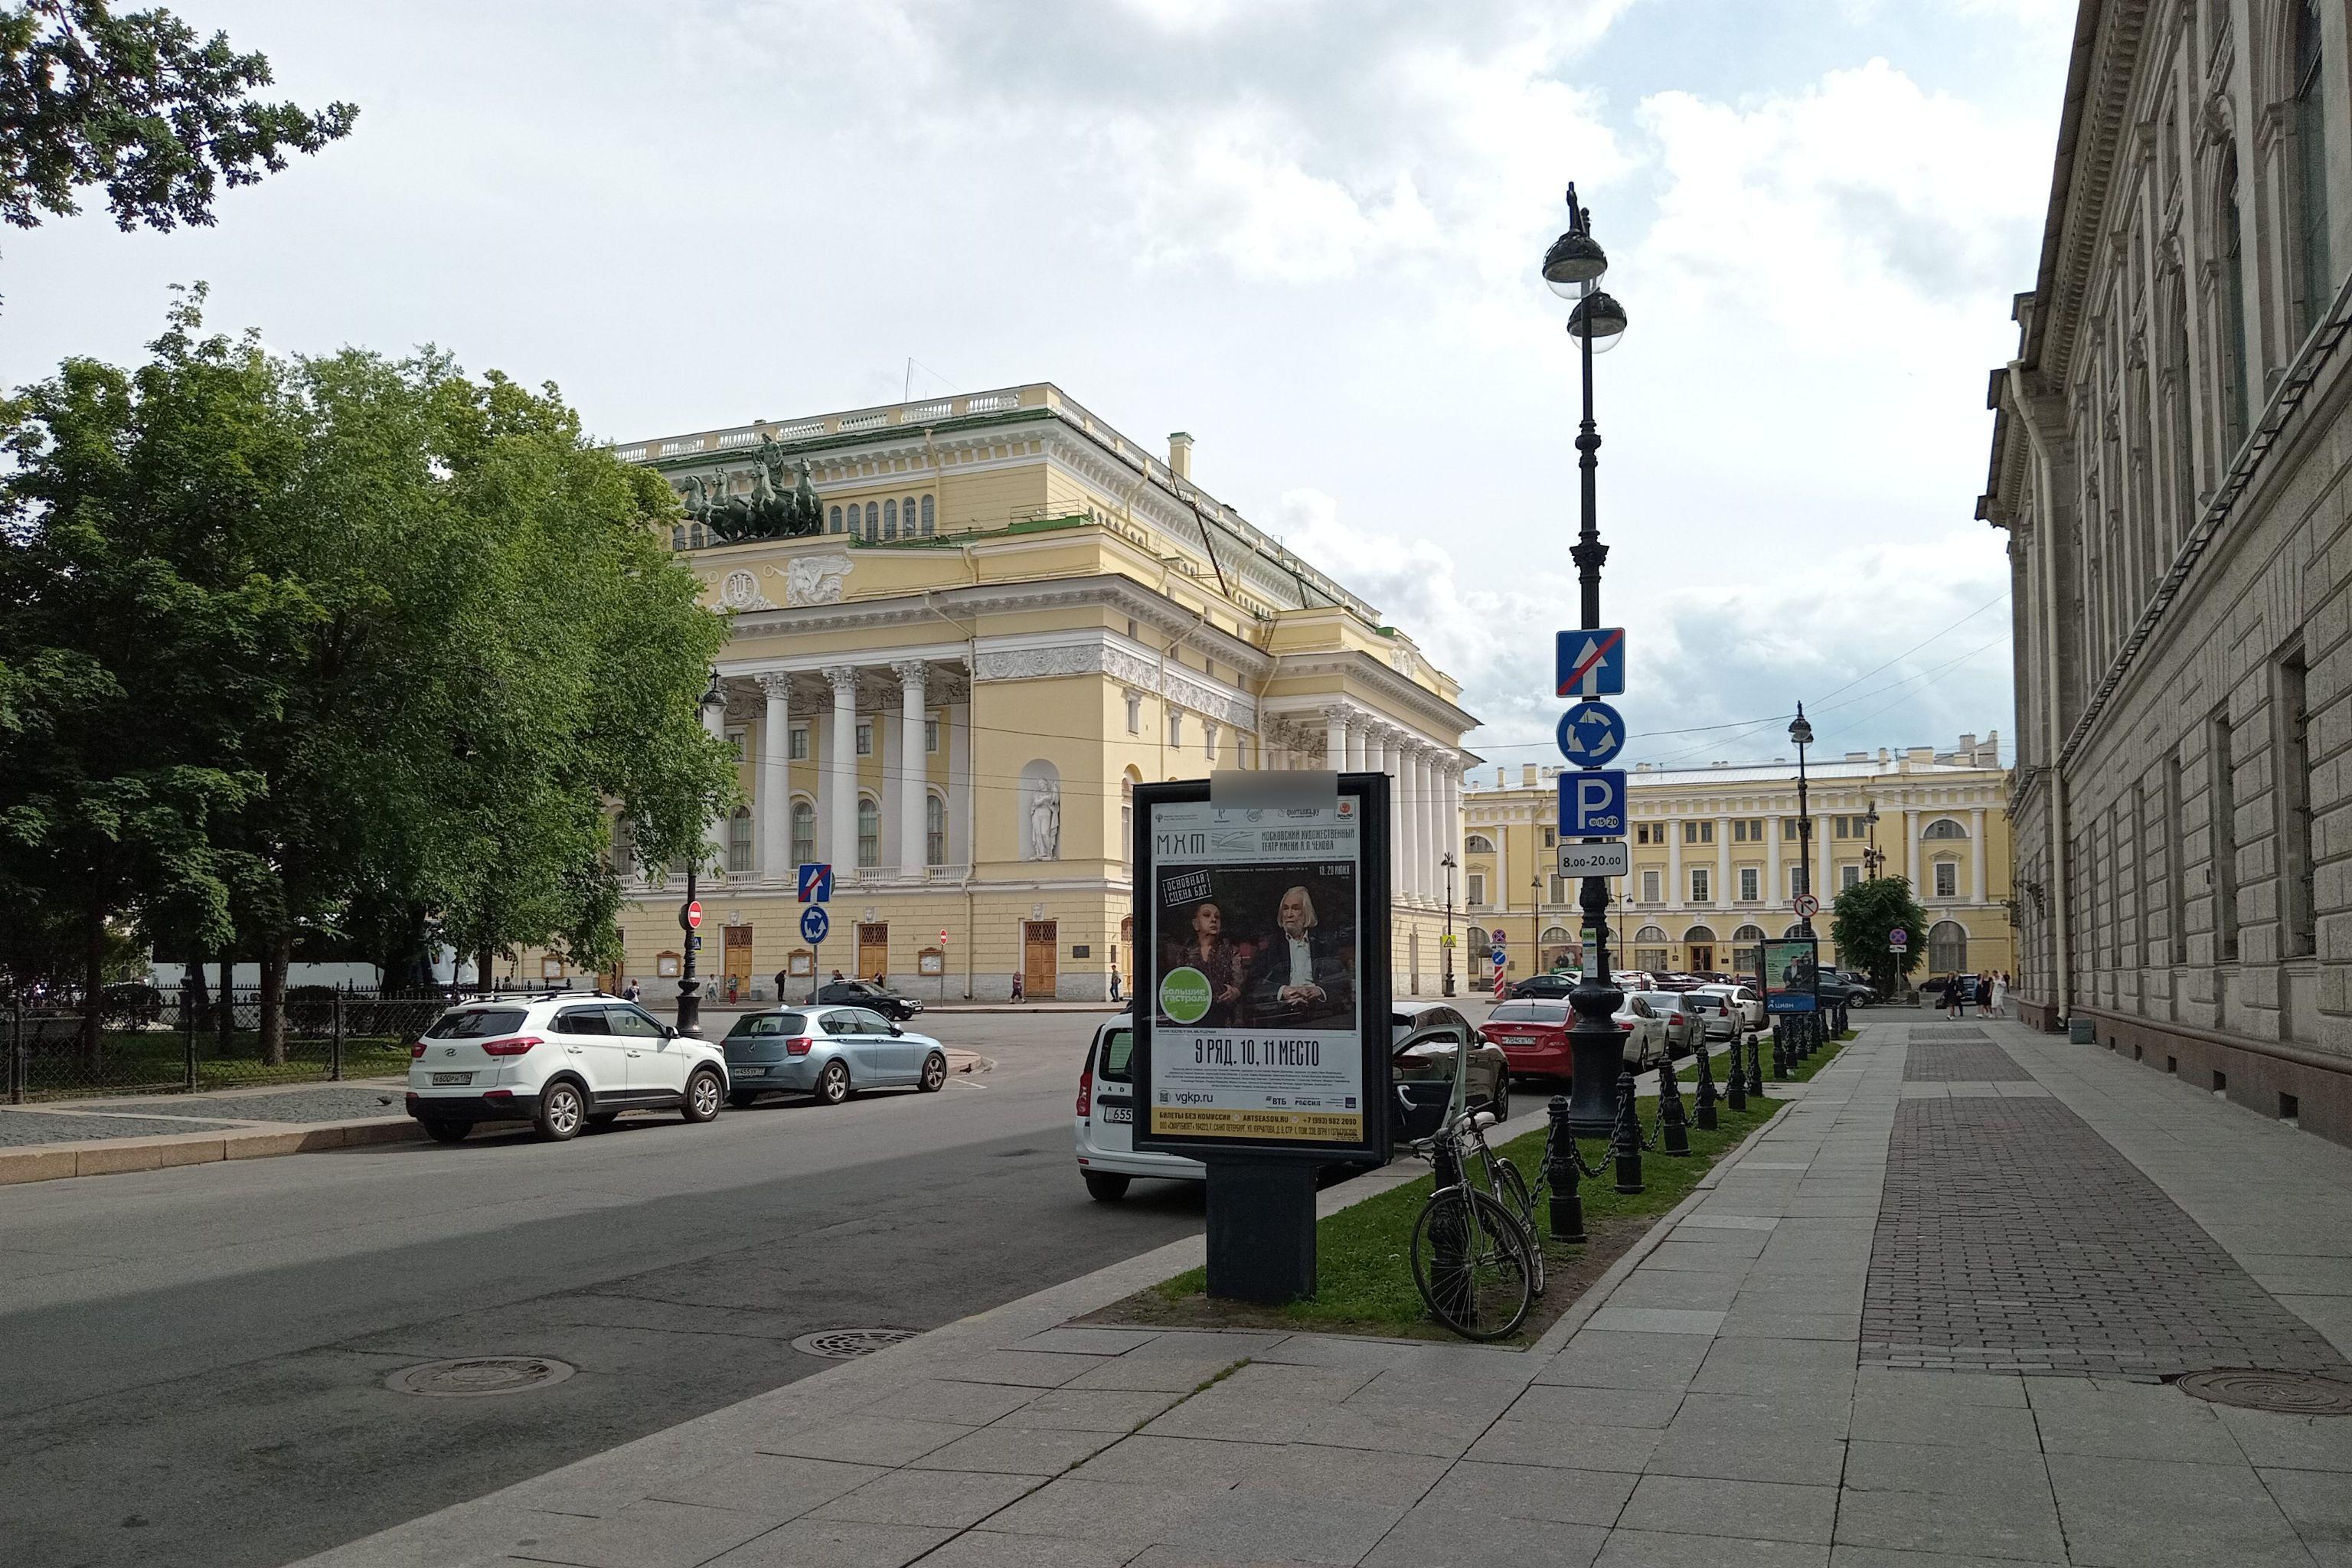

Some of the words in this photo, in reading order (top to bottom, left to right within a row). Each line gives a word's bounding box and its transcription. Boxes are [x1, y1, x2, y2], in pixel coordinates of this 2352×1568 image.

[1577, 779, 1613, 829] P
[1261, 829, 1300, 841] МОСКОВСКИЙ
[1301, 828, 1355, 840] ХУДОЖЕСТВЕННЫЙ
[1262, 841, 1278, 851] ТЕАТР
[1279, 841, 1298, 851] ИМЕНИ
[1312, 840, 1334, 850] ЧЕХОВА
[1563, 854, 1621, 867] 8.00-20.00
[1327, 865, 1334, 875] 20
[1166, 873, 1205, 891] ОСНОВНАЯ
[1168, 888, 1193, 903] СЦЕНА
[1194, 884, 1207, 897] БДТ
[1162, 986, 1206, 995] Большие
[1165, 995, 1209, 1004] гастроли
[1195, 1038, 1203, 1063] 9
[1207, 1039, 1237, 1066] РЯД.
[1240, 1039, 1259, 1067] 10,
[1263, 1040, 1275, 1065] 11
[1279, 1040, 1319, 1067] МЕСТО
[1175, 1091, 1214, 1104] vgkp.ru
[1243, 1115, 1289, 1123] ARTSEASON.RU
